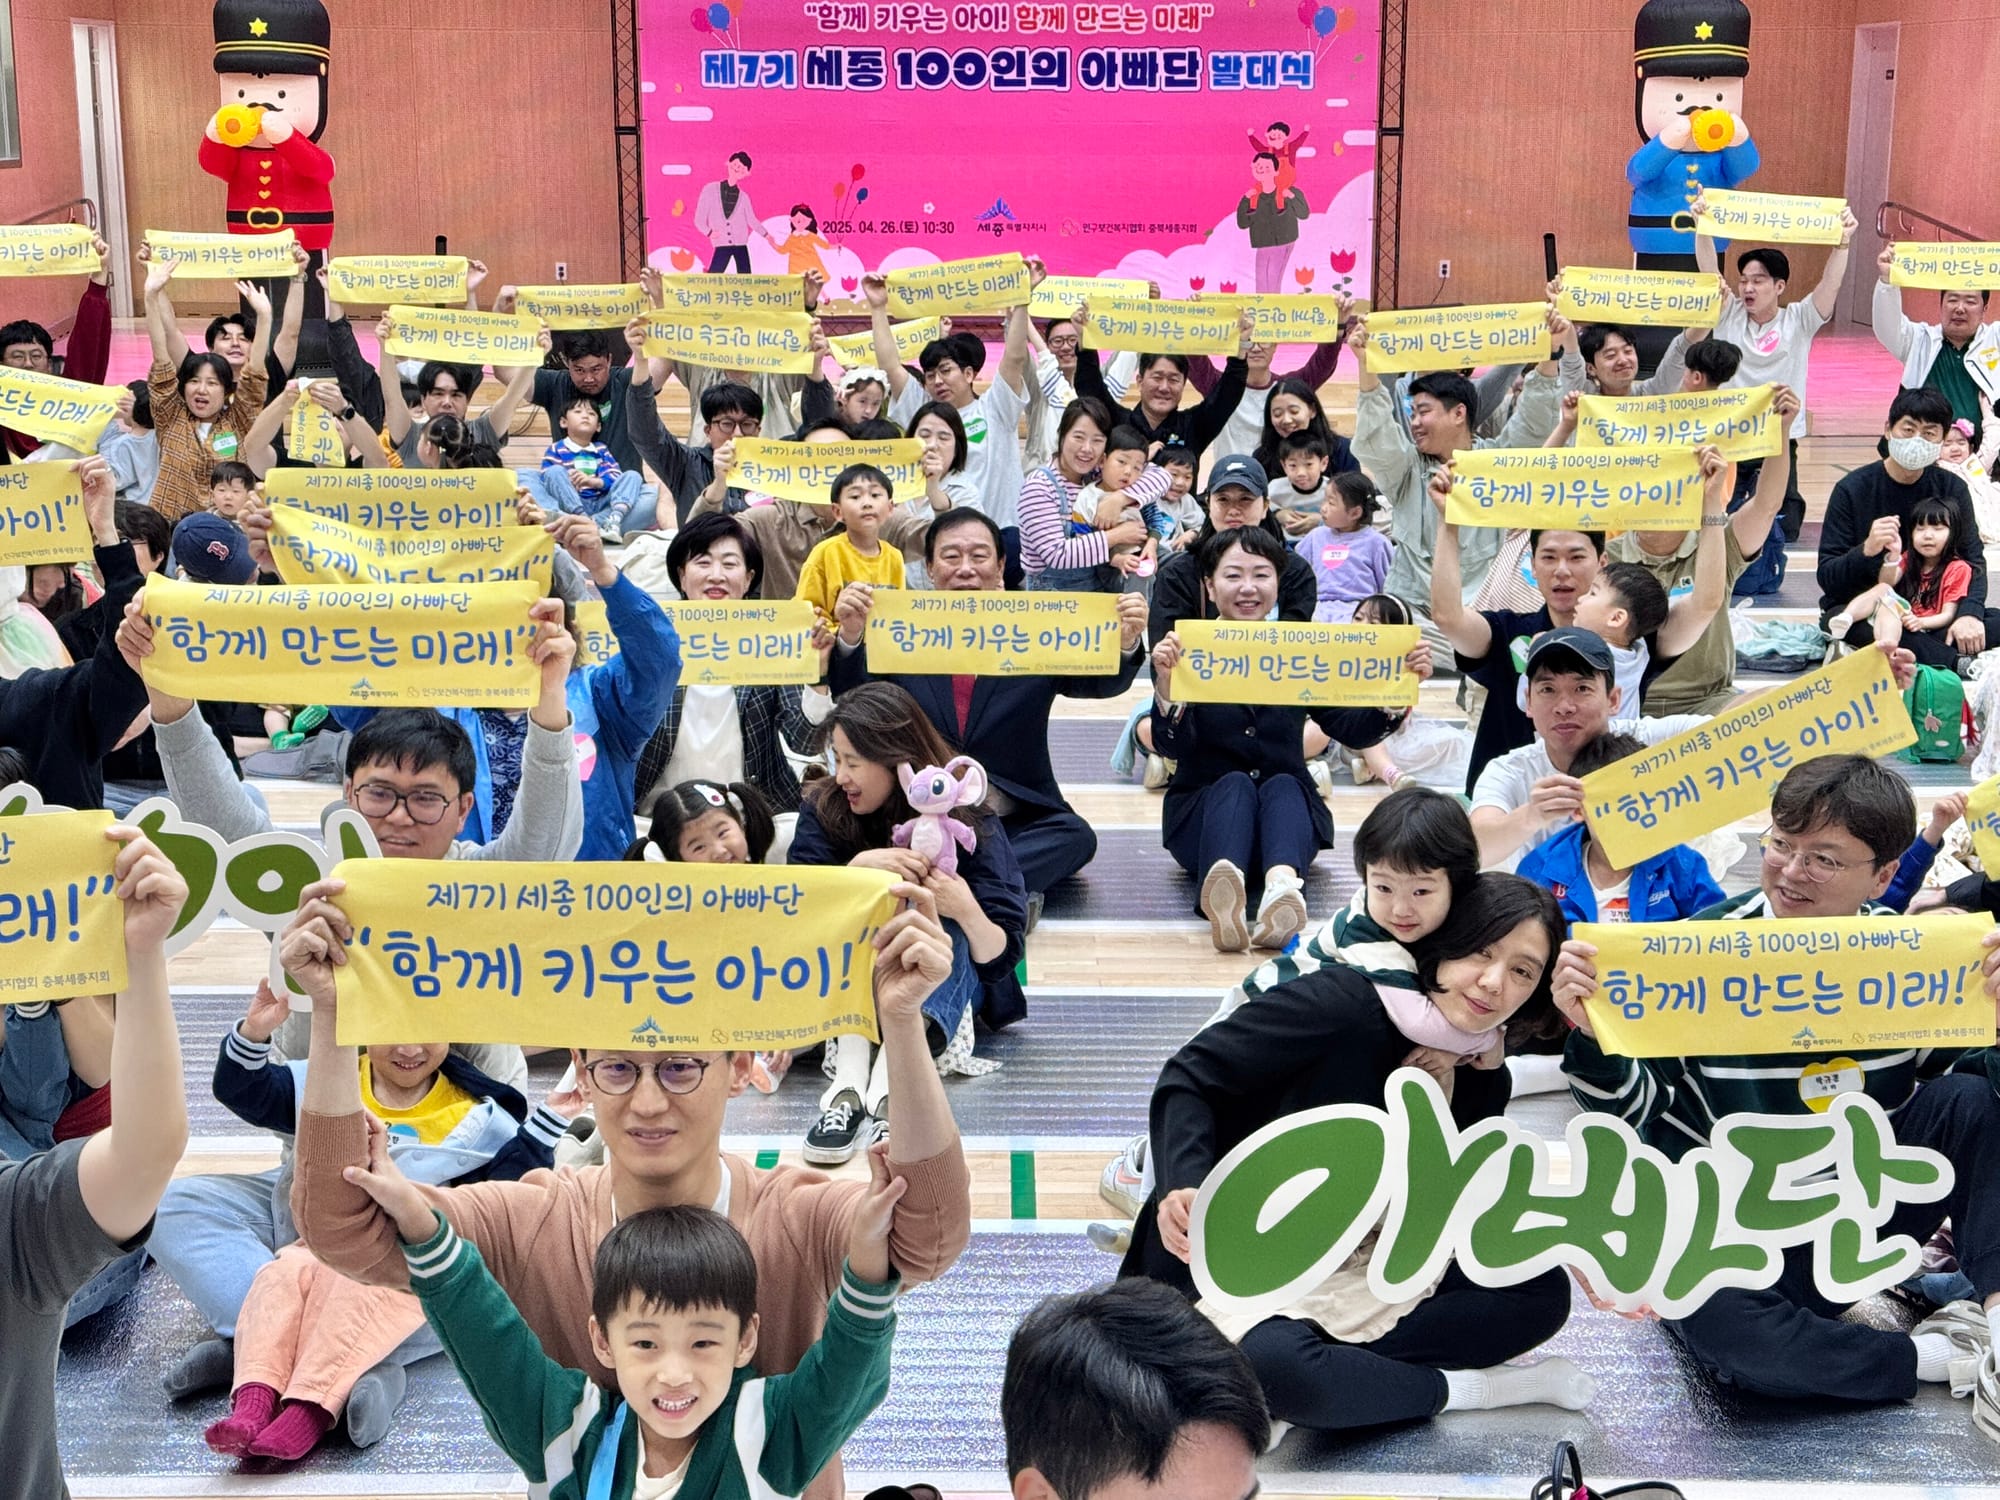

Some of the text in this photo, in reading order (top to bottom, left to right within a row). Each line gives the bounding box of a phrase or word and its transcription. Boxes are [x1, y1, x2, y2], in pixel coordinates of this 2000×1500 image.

[806, 5, 1213, 31] "함께 키우는 아이! 함께 만드는 미래"
[703, 48, 1311, 88] 제7기 세종 100인의 아빠단 발대식
[822, 220, 955, 236] 2025. 04. 26.(토) 10:30
[976, 223, 1005, 238] 세종
[1752, 210, 1792, 229] 키우는
[50, 241, 89, 259] 아이!
[201, 246, 243, 264] 키우는
[1942, 259, 1985, 276] 만드는
[330, 270, 375, 288] "함께
[378, 272, 421, 290] 만드는
[887, 284, 934, 305] "함께
[937, 278, 980, 301] 만드는
[982, 268, 1028, 291] 미래!"
[566, 302, 602, 318] 키우는
[665, 288, 802, 308] "함께 키우는 아이!"
[1560, 284, 1721, 313] "함께 만드는 미래!"
[1087, 313, 1137, 337] "함께
[1141, 318, 1185, 341] 키우는
[1394, 308, 1519, 327] 제7기 세종 100인의 아빠단
[443, 331, 489, 351] 만드는
[1367, 321, 1550, 356] "함께 만드는 미래!"
[39, 400, 114, 425] 미래!"
[1614, 393, 1749, 415] 제7기 세종 100인의 아빠단
[1581, 416, 1648, 447] "함께
[1653, 419, 1708, 444] 키우는
[760, 446, 894, 458] 제7기 세종 100인의 아빠단
[1491, 453, 1662, 470] 제7기 세종 100인의 아빠단
[304, 474, 477, 492] 제7기 세종 100인의 아빠단
[1453, 474, 1702, 509] "함께 키우는 아이!"
[357, 498, 519, 532] 키우는 아이!"
[271, 534, 359, 579] "함께
[356, 534, 388, 557] 세종
[389, 538, 446, 557] 100인의
[450, 535, 505, 555] 아빠단
[203, 588, 473, 613] 제7기 세종 100인의 아빠단
[911, 596, 1080, 615] 제7기 세종 100인의 아빠단
[679, 607, 778, 622] 100인의 아빠단
[281, 624, 399, 668] 만드는
[410, 624, 539, 667] 미래!"
[870, 618, 1118, 653] "함께 키우는 아이!"
[1213, 627, 1380, 646] 제7기 세종 100인의 아빠단
[1258, 654, 1331, 683] 만드는
[1630, 676, 1833, 778] 제7기 세종 100인의 아빠단
[1594, 678, 1889, 830] "함께 키우는 아이!"
[426, 878, 805, 918] 제7기 세종 100인의 아빠단
[1642, 927, 1924, 959] 제7기 세종 100인의 아빠단
[344, 925, 876, 1005] "함께 키우는 아이!"
[42, 970, 110, 988] 충북세종지회
[1601, 969, 1707, 1020] 함께
[1722, 969, 1845, 1018] 만드는
[631, 1025, 818, 1048] 세종 특별자치시 인구보건복지협회
